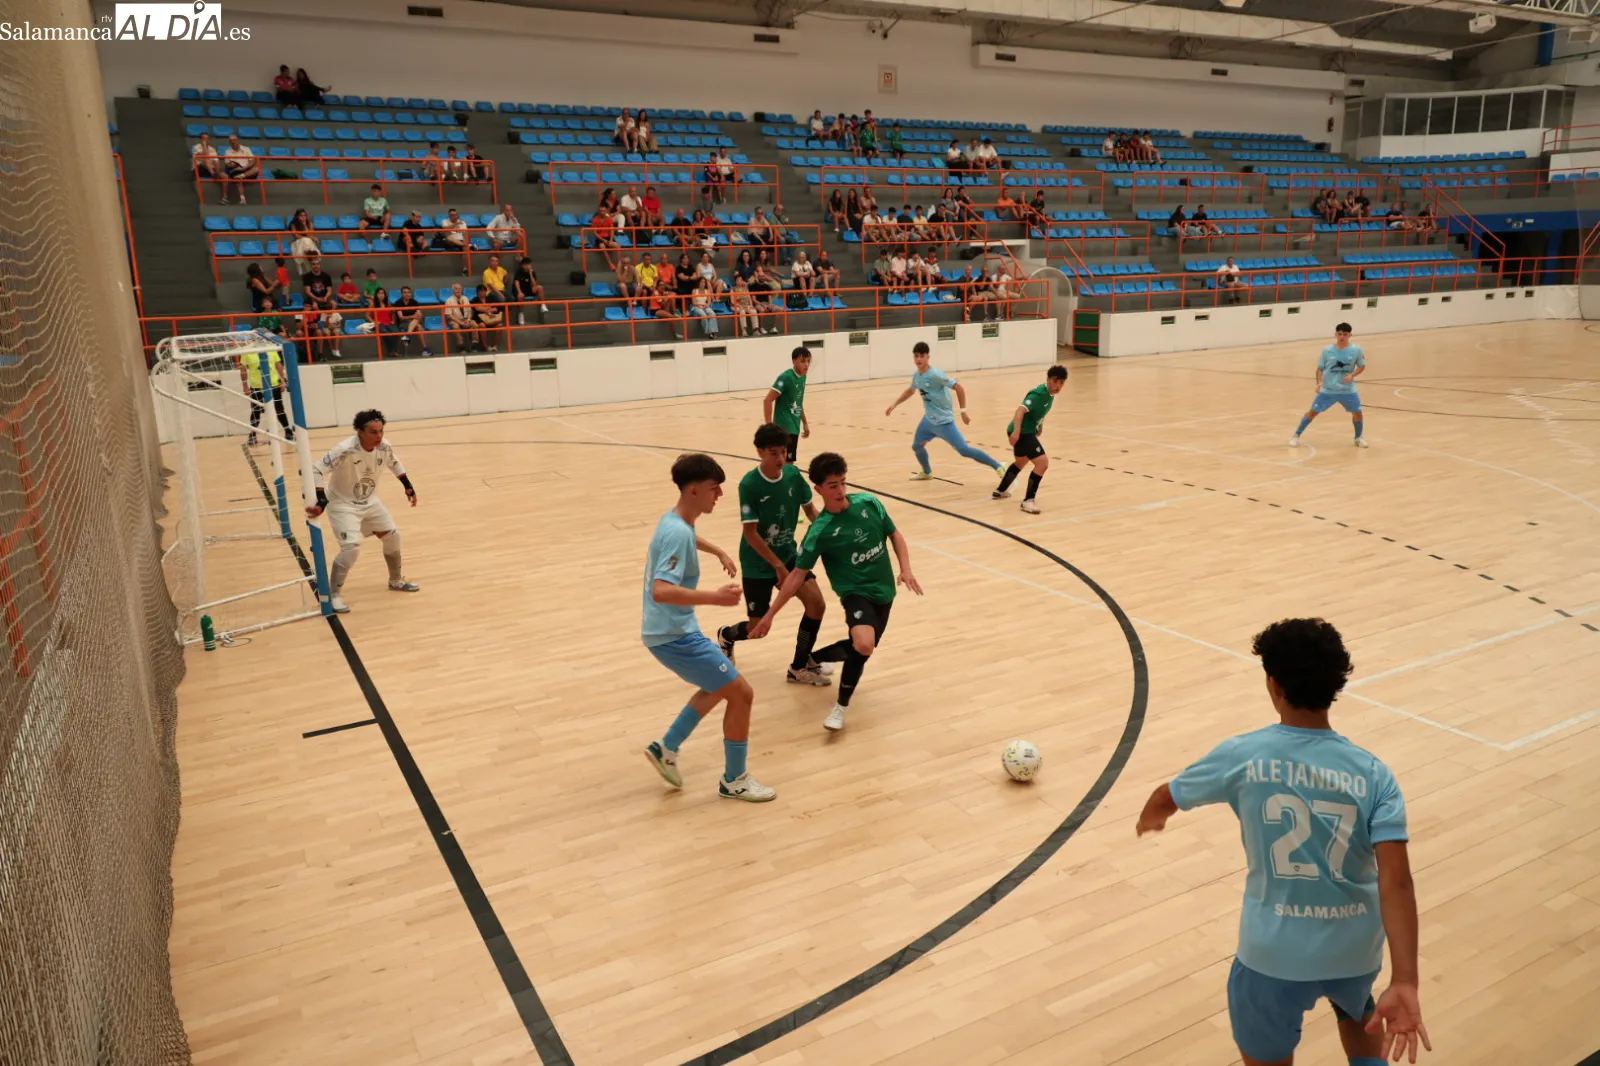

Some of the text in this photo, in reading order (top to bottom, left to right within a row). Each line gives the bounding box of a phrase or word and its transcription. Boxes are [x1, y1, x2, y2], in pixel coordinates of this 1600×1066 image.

[1245, 759, 1367, 798] ALEJANDRO
[1262, 794, 1358, 882] 27
[1274, 902, 1367, 919] SALAMANCA
